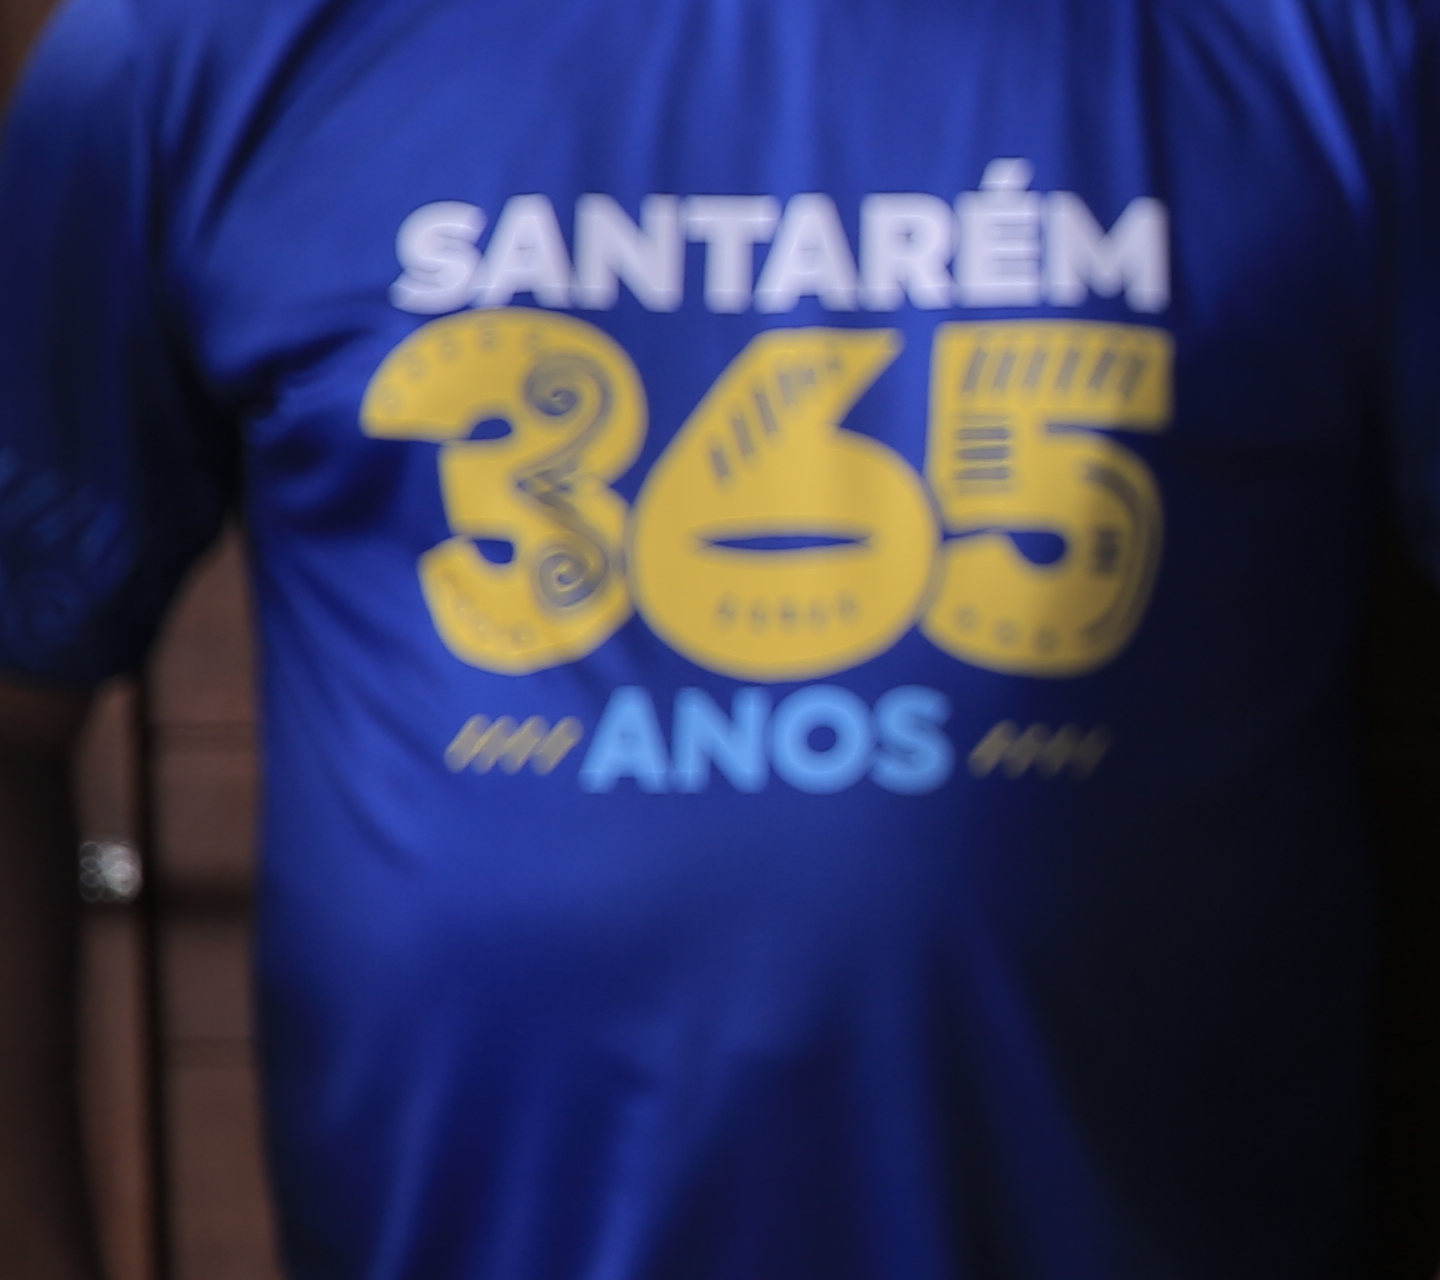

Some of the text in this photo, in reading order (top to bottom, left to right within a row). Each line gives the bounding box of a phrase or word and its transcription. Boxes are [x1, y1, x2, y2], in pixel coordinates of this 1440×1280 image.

[391, 158, 1170, 314] SANTARÉM
[358, 306, 1175, 683] 365
[578, 684, 955, 795] ANOS
